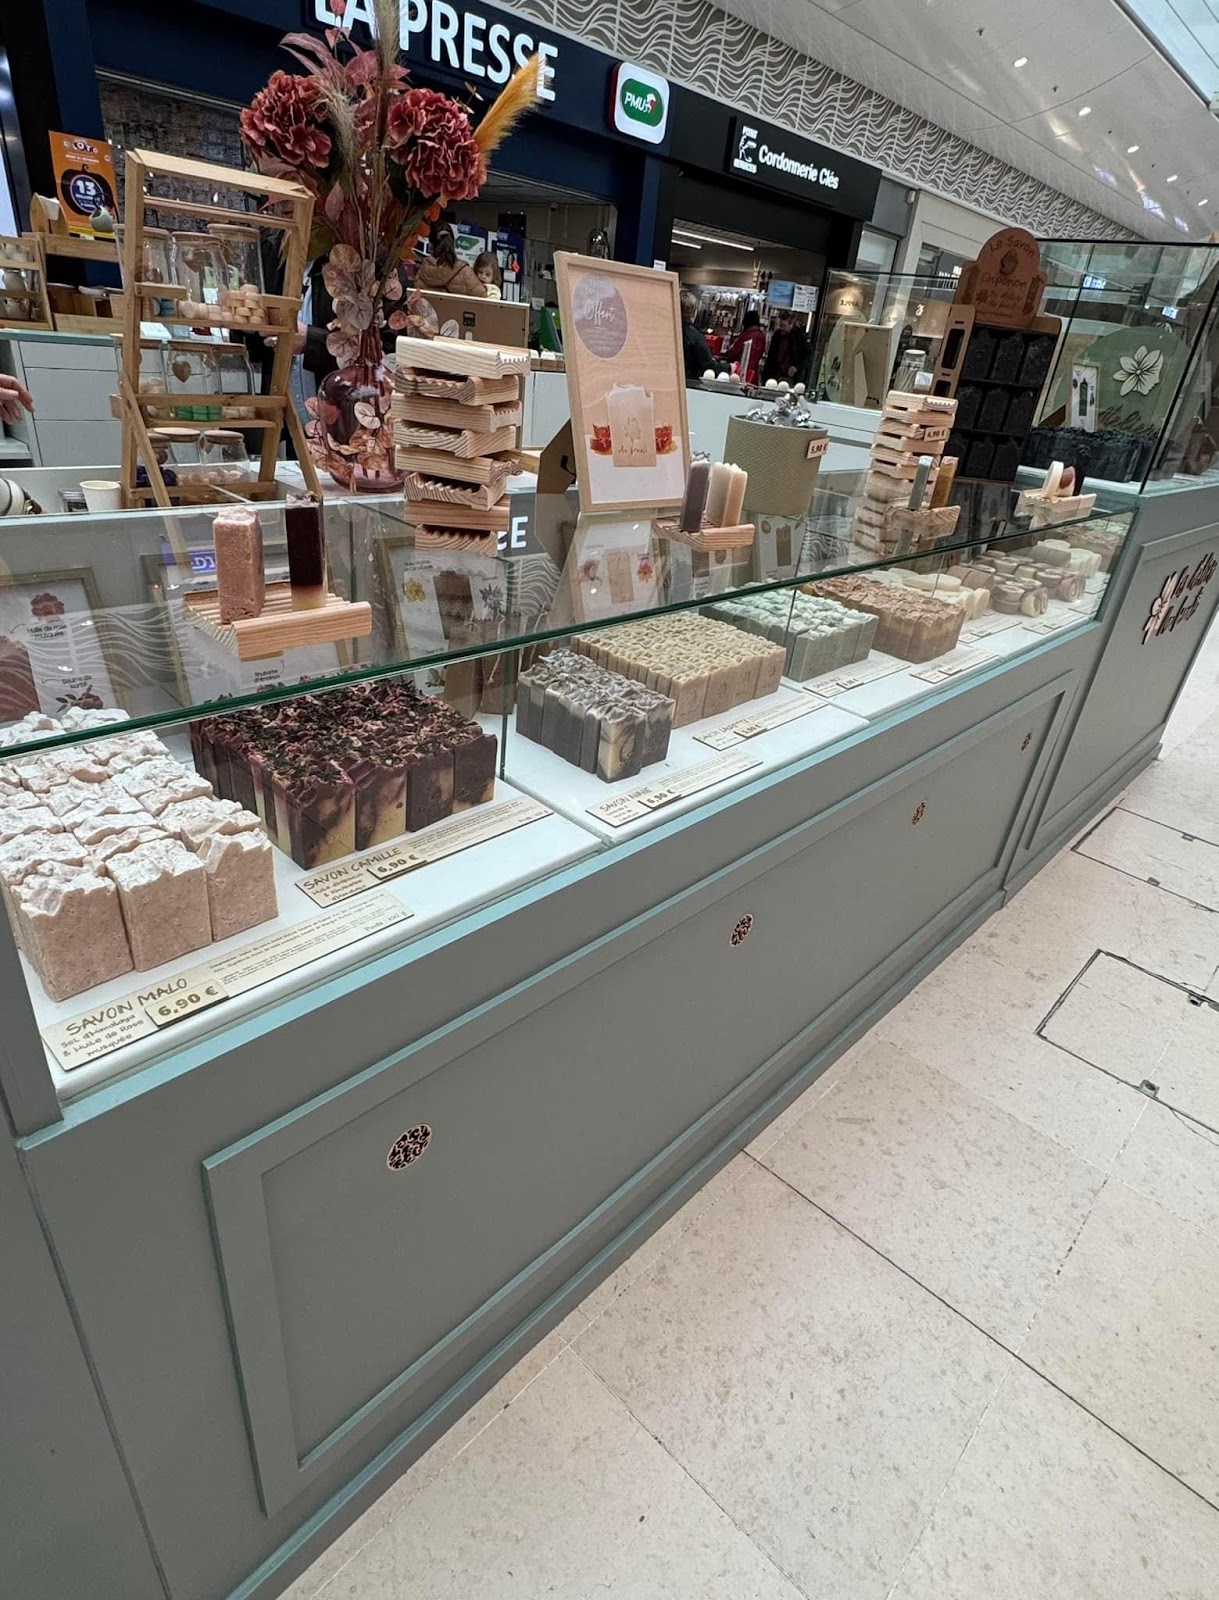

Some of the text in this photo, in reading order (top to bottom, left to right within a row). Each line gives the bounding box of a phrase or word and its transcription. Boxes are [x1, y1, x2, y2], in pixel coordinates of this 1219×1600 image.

[400, 0, 558, 101] PRESSE
[624, 91, 647, 112] PMU
[758, 144, 839, 190] Cordonnerie Clés
[76, 179, 97, 197] 13
[303, 847, 402, 891] SAVON CAMILLE
[65, 977, 188, 1036] SAVON MALO
[204, 985, 219, 996] €
[104, 1029, 118, 1040] de
[120, 1018, 145, 1032] Rose
